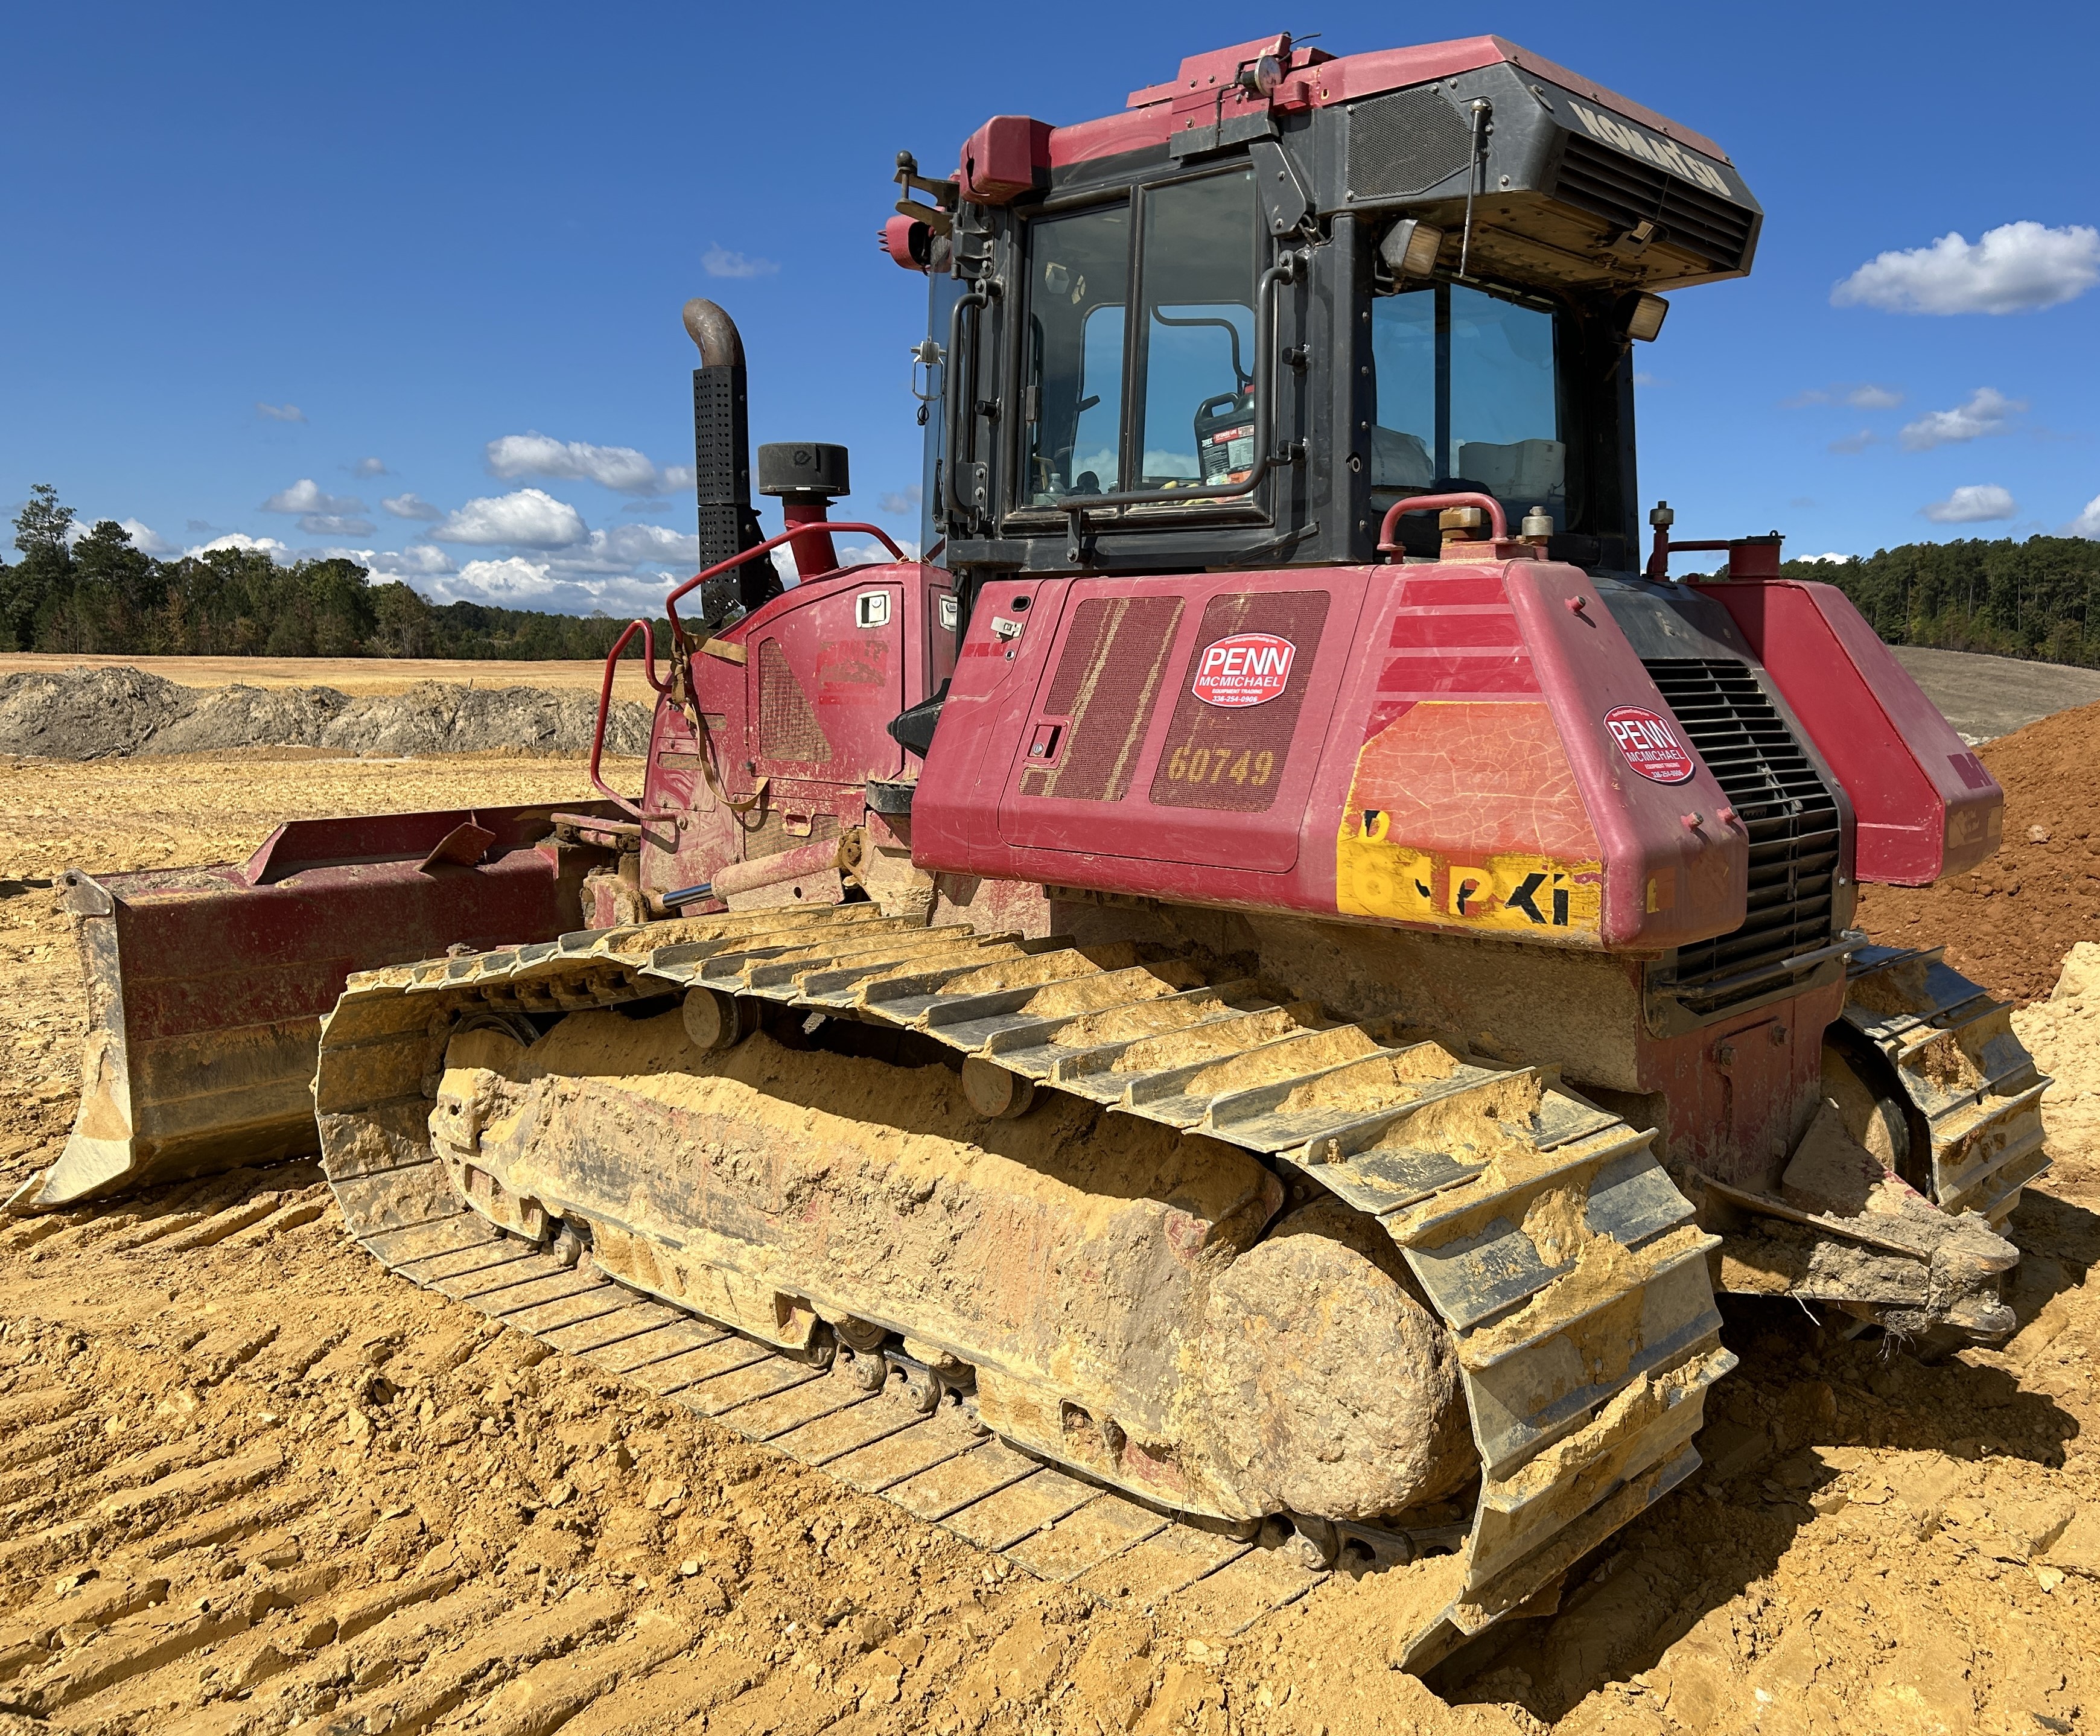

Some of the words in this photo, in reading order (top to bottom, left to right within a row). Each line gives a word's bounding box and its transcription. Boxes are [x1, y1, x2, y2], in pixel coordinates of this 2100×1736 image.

[1568, 100, 1731, 196] KOMATSU
[1203, 647, 1290, 675] PENN
[1198, 676, 1281, 687] MCMICHAEL
[1608, 720, 1678, 750] PENN
[1168, 746, 1273, 785] 60749
[1625, 750, 1685, 762] MCMICHAEL
